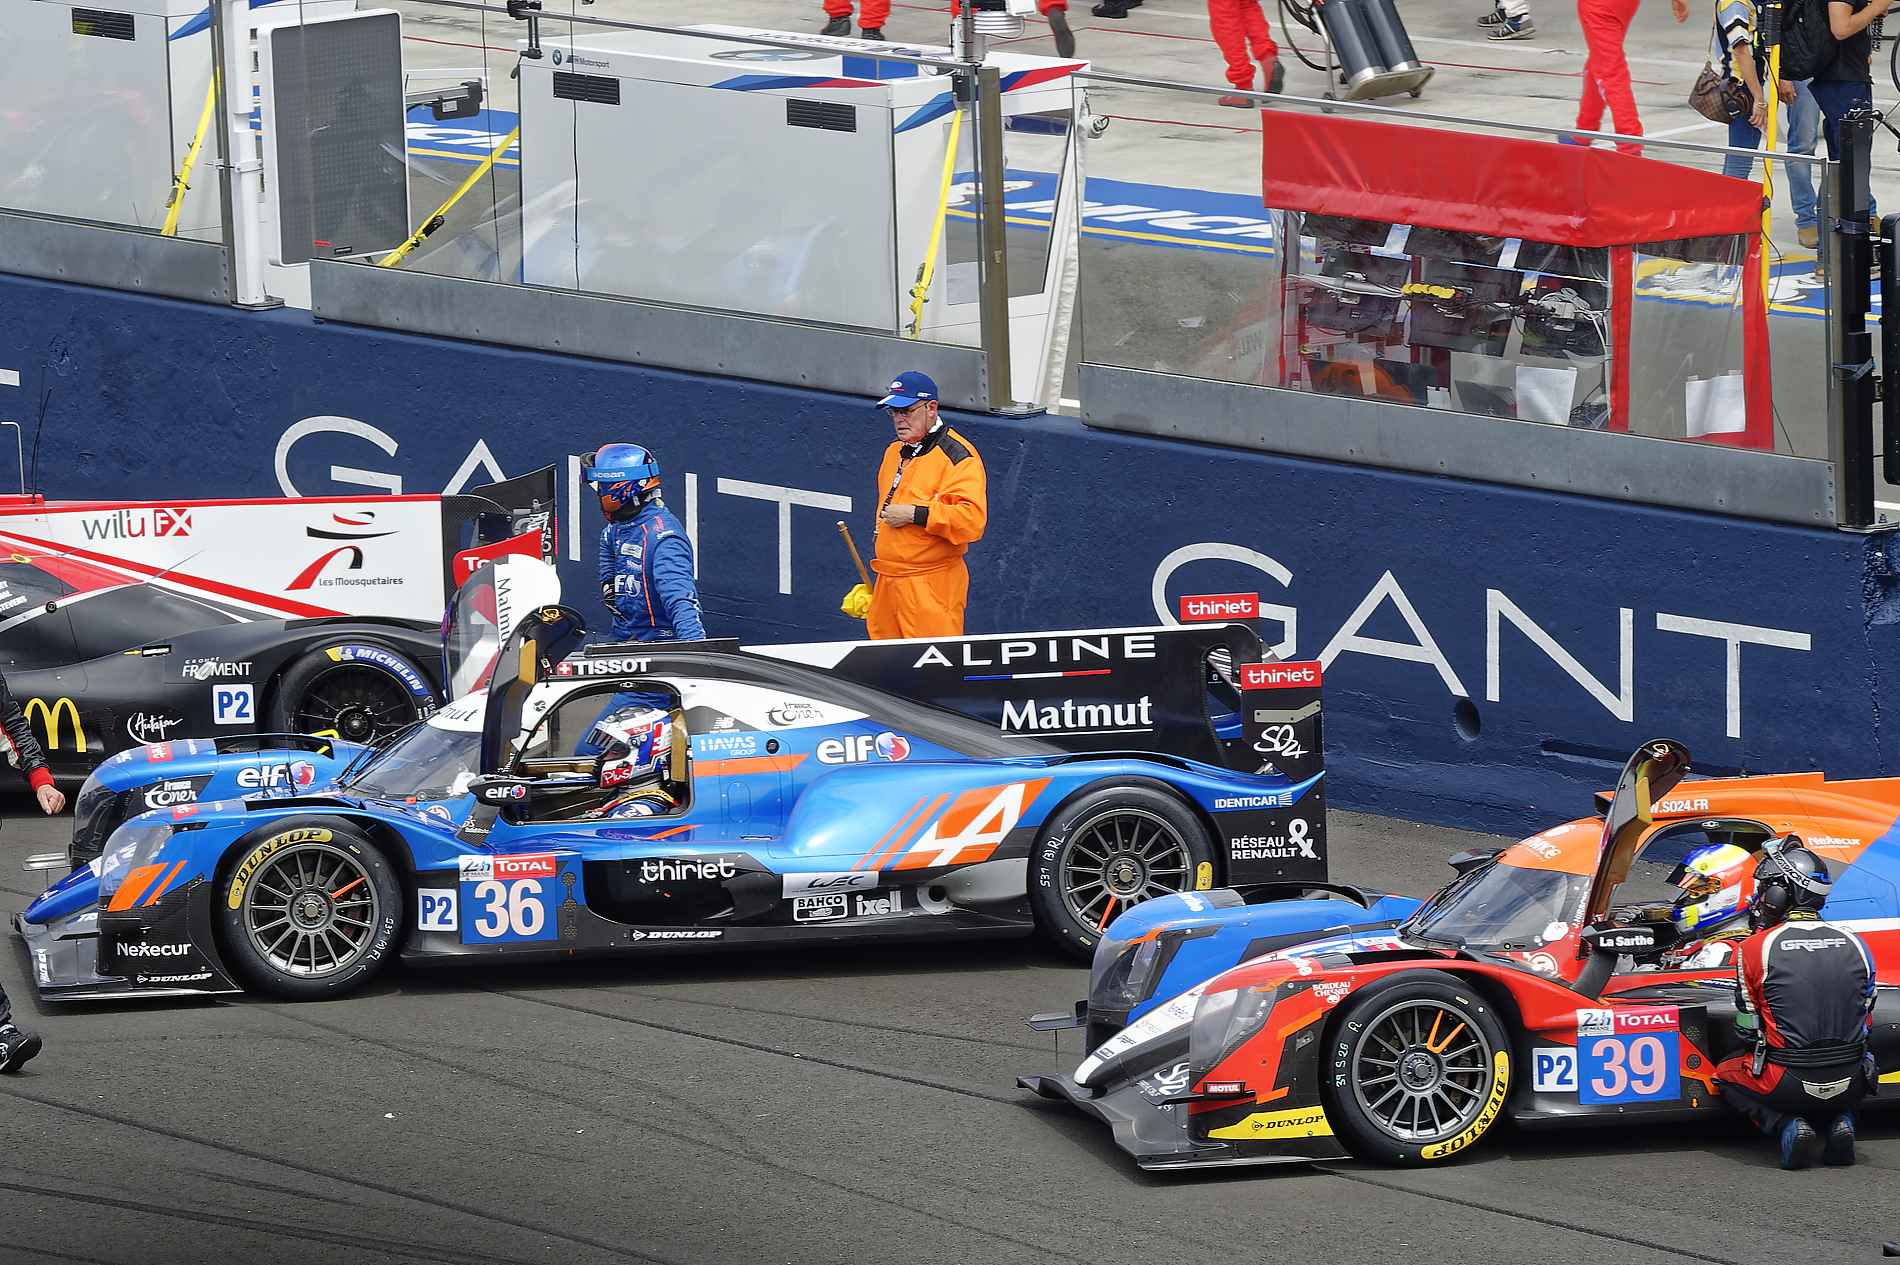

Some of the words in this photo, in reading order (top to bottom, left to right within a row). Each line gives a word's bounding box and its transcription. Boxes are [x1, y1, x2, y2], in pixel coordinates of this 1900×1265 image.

[153, 508, 192, 537] FX
[335, 576, 404, 588] Mousquetaires
[1187, 599, 1252, 617] thiriet
[1152, 542, 1811, 738] GANT
[912, 634, 1157, 669] ALPINE
[356, 648, 424, 691] MICHELIN
[572, 657, 652, 676] TISSOT
[1248, 667, 1315, 684] thiriet
[217, 691, 250, 718] P2
[1000, 695, 1154, 731] Matmut
[700, 736, 757, 752] HAVAS
[817, 734, 873, 764] elf
[485, 786, 511, 798] elf
[1215, 794, 1277, 809] IDENTICAR
[1231, 835, 1284, 849] RÉSEAU
[236, 829, 322, 887] DUNLOP
[1231, 847, 1297, 860] RENAULT
[495, 860, 553, 873] TOTAL
[639, 857, 736, 884] thiriet
[421, 895, 453, 925] P2
[474, 878, 545, 938] 36
[797, 895, 843, 908] BAHCO
[856, 890, 902, 916] ixell
[647, 930, 723, 939] DUNLOP
[1599, 937, 1615, 947] La
[1615, 936, 1654, 947] Sarthe
[148, 972, 213, 982] DUNLOP
[1616, 1013, 1676, 1027] TOTAL
[1537, 1054, 1573, 1086] P2
[1591, 1036, 1666, 1097] 39
[1207, 1083, 1241, 1093] MOTUL
[1266, 1114, 1325, 1131] DUNLOP
[1432, 1080, 1505, 1157] DUNLOP
